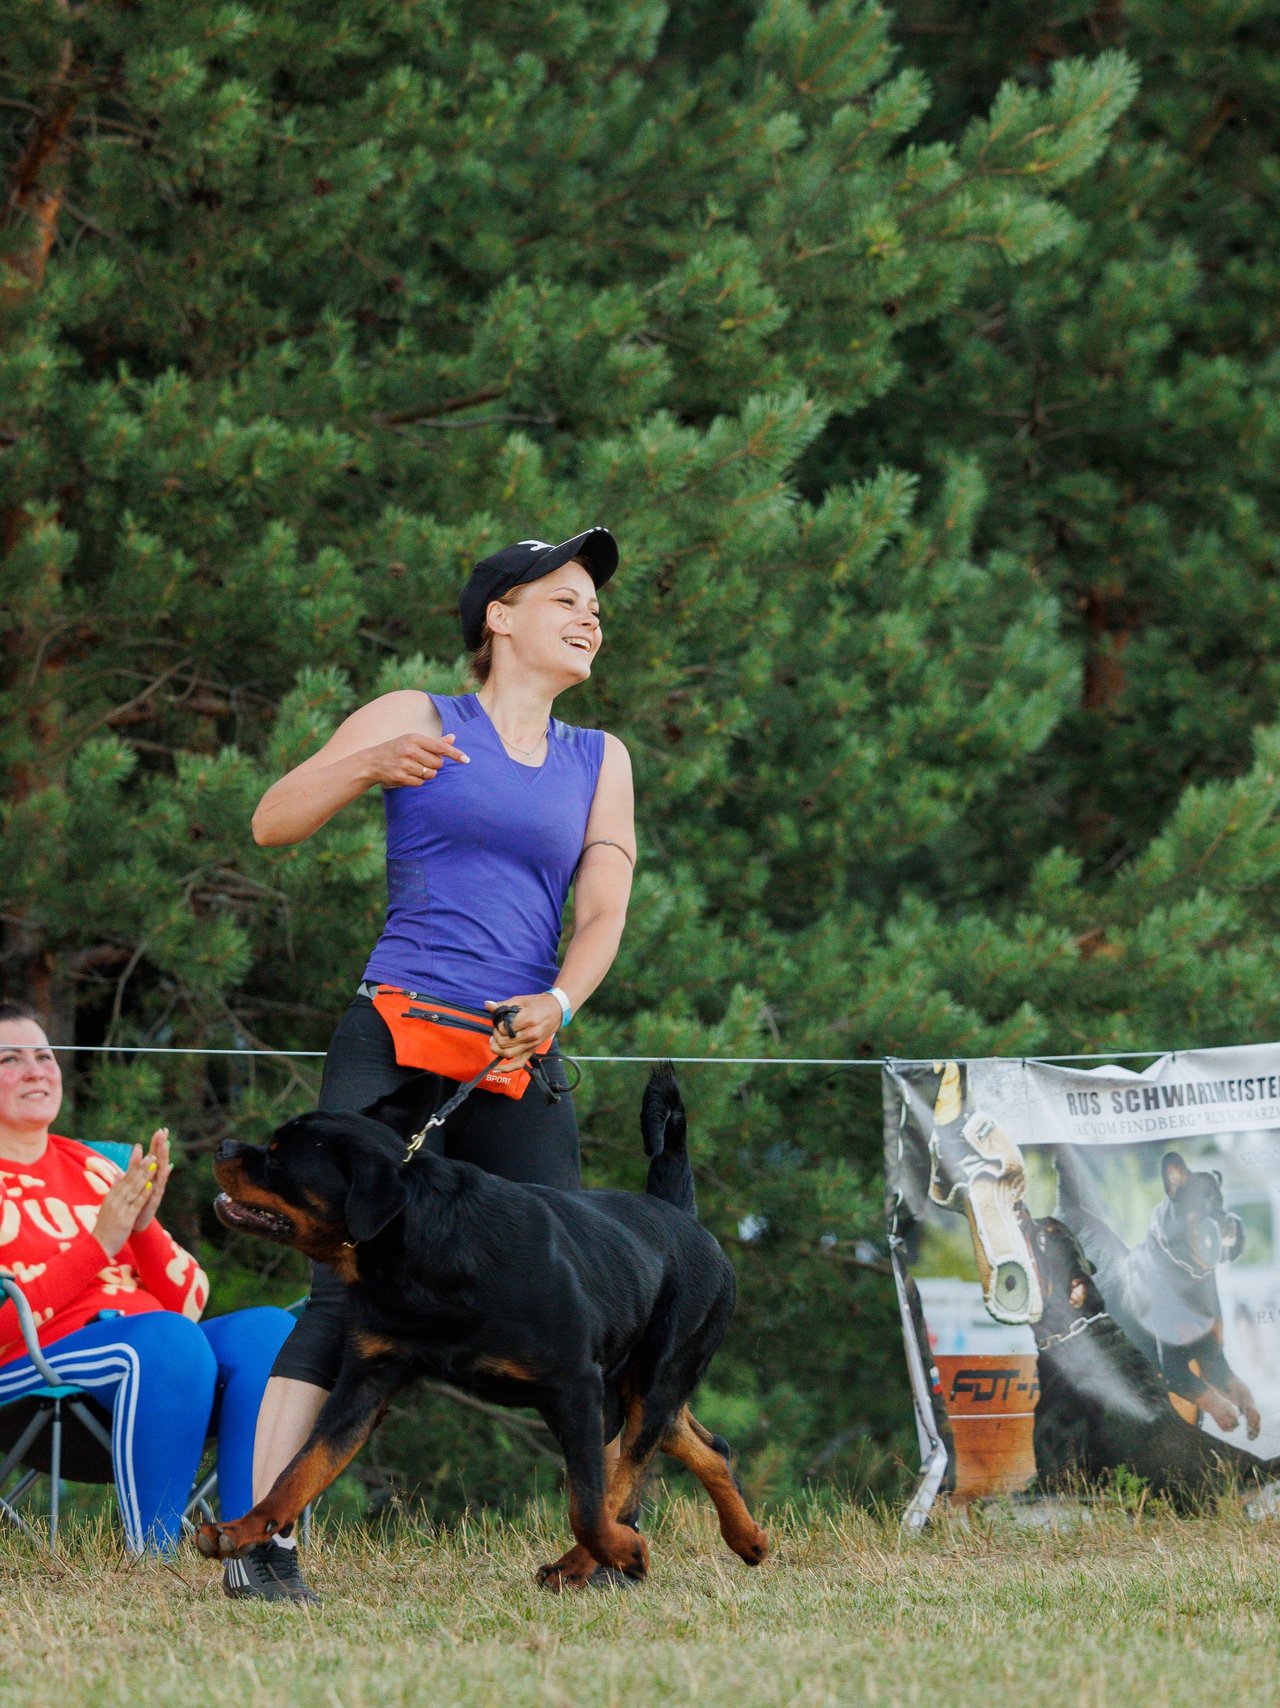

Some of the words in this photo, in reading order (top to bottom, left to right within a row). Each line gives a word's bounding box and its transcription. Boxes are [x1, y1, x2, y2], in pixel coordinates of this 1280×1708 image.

[486, 1074, 511, 1085] SPORT
[1066, 1092, 1101, 1116] RUS
[1090, 1122, 1117, 1136] VOM
[1120, 1113, 1196, 1135] FINDBERG
[1204, 1111, 1225, 1126] RUS
[1257, 1310, 1275, 1324] НА
